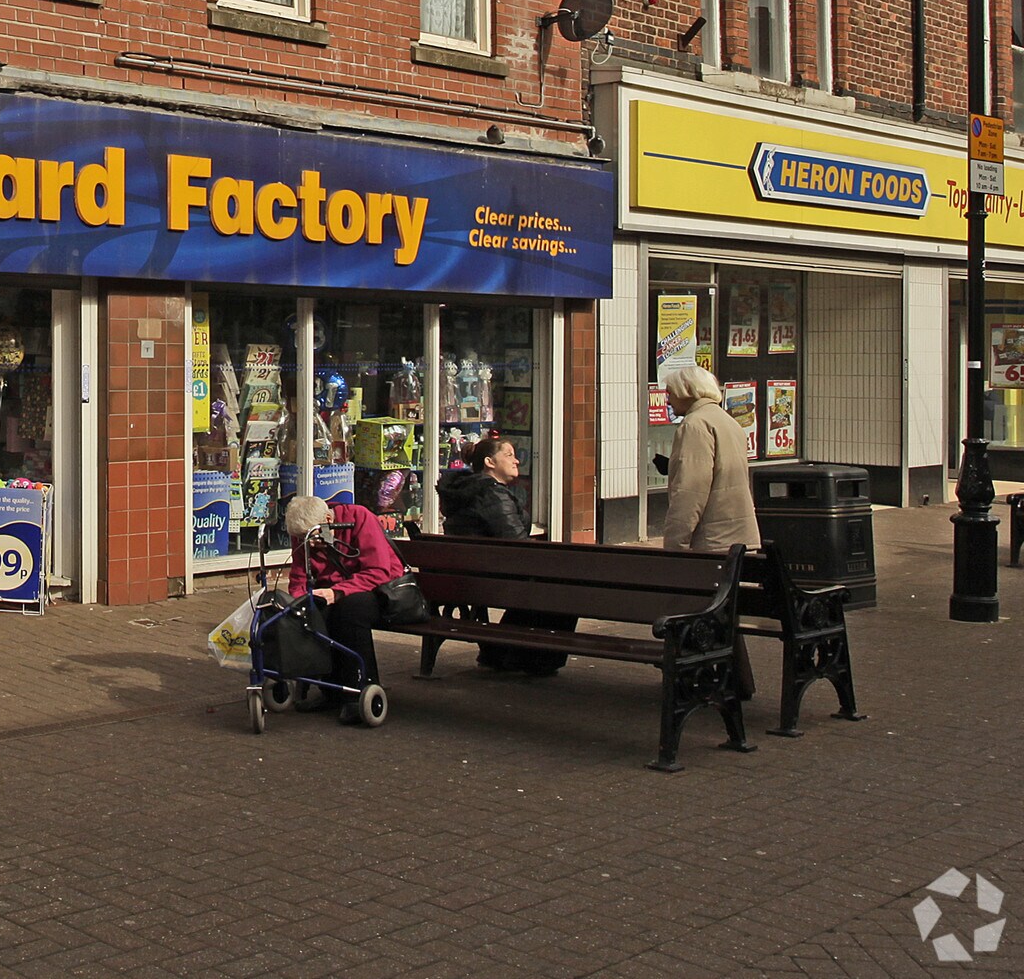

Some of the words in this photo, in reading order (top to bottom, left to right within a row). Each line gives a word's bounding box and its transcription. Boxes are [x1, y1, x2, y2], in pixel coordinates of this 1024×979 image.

[983, 121, 1002, 131] Pedestrian
[984, 164, 997, 174] loading
[780, 159, 855, 195] HERON
[860, 171, 923, 205] FOODS
[946, 179, 968, 218] Top
[166, 153, 429, 266] Factory
[475, 205, 514, 226] Clear
[517, 211, 572, 232] prices...
[468, 228, 508, 248] Clear
[512, 234, 577, 257] savings...
[732, 327, 757, 347] £1.65
[773, 325, 795, 344] £1.25
[256, 352, 273, 365] 21
[257, 368, 271, 379] 21
[192, 382, 205, 397] £1
[256, 391, 267, 403] 18
[775, 428, 794, 449] 65p
[248, 480, 260, 494] 3
[195, 529, 215, 545] and
